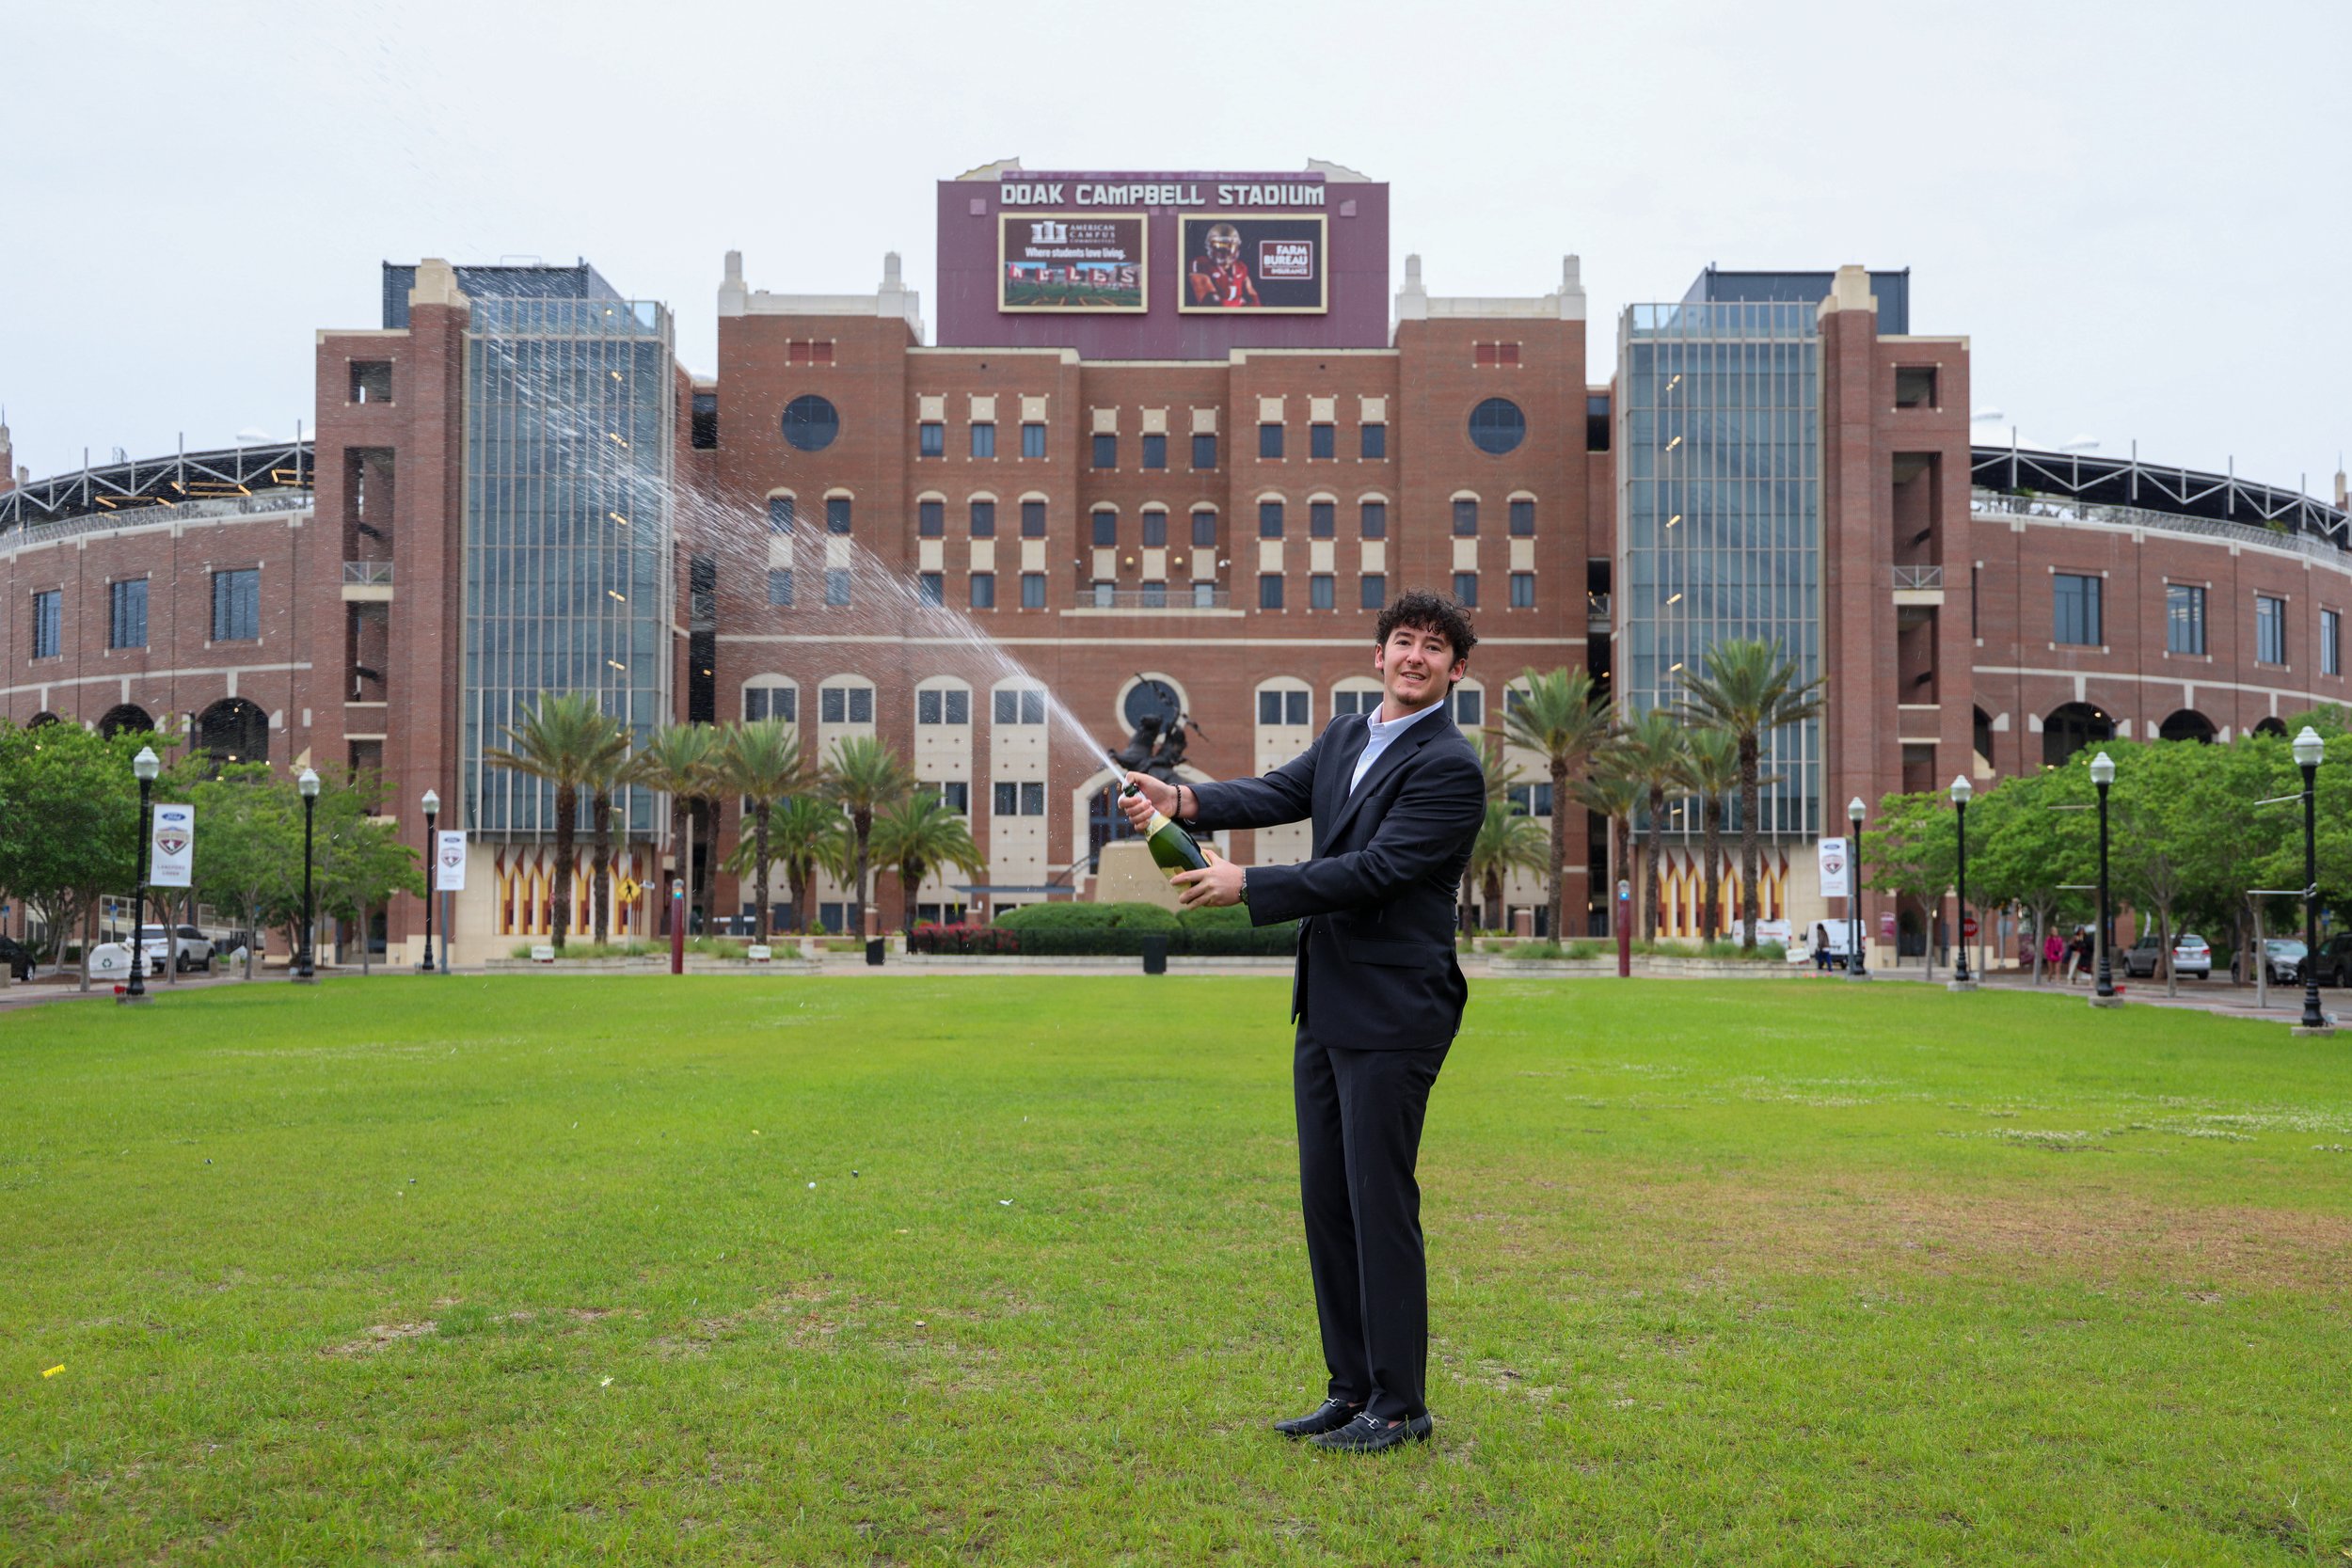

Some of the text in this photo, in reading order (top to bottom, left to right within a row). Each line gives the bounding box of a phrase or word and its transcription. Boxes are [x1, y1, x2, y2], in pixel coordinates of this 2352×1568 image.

[1001, 184, 1325, 205] DOAK CAMPBELL STADIUM
[1025, 247, 1050, 258] Where
[1052, 248, 1084, 258] students
[1086, 248, 1102, 258] love
[1277, 245, 1308, 255] FARM
[1263, 255, 1308, 265] BUREAU
